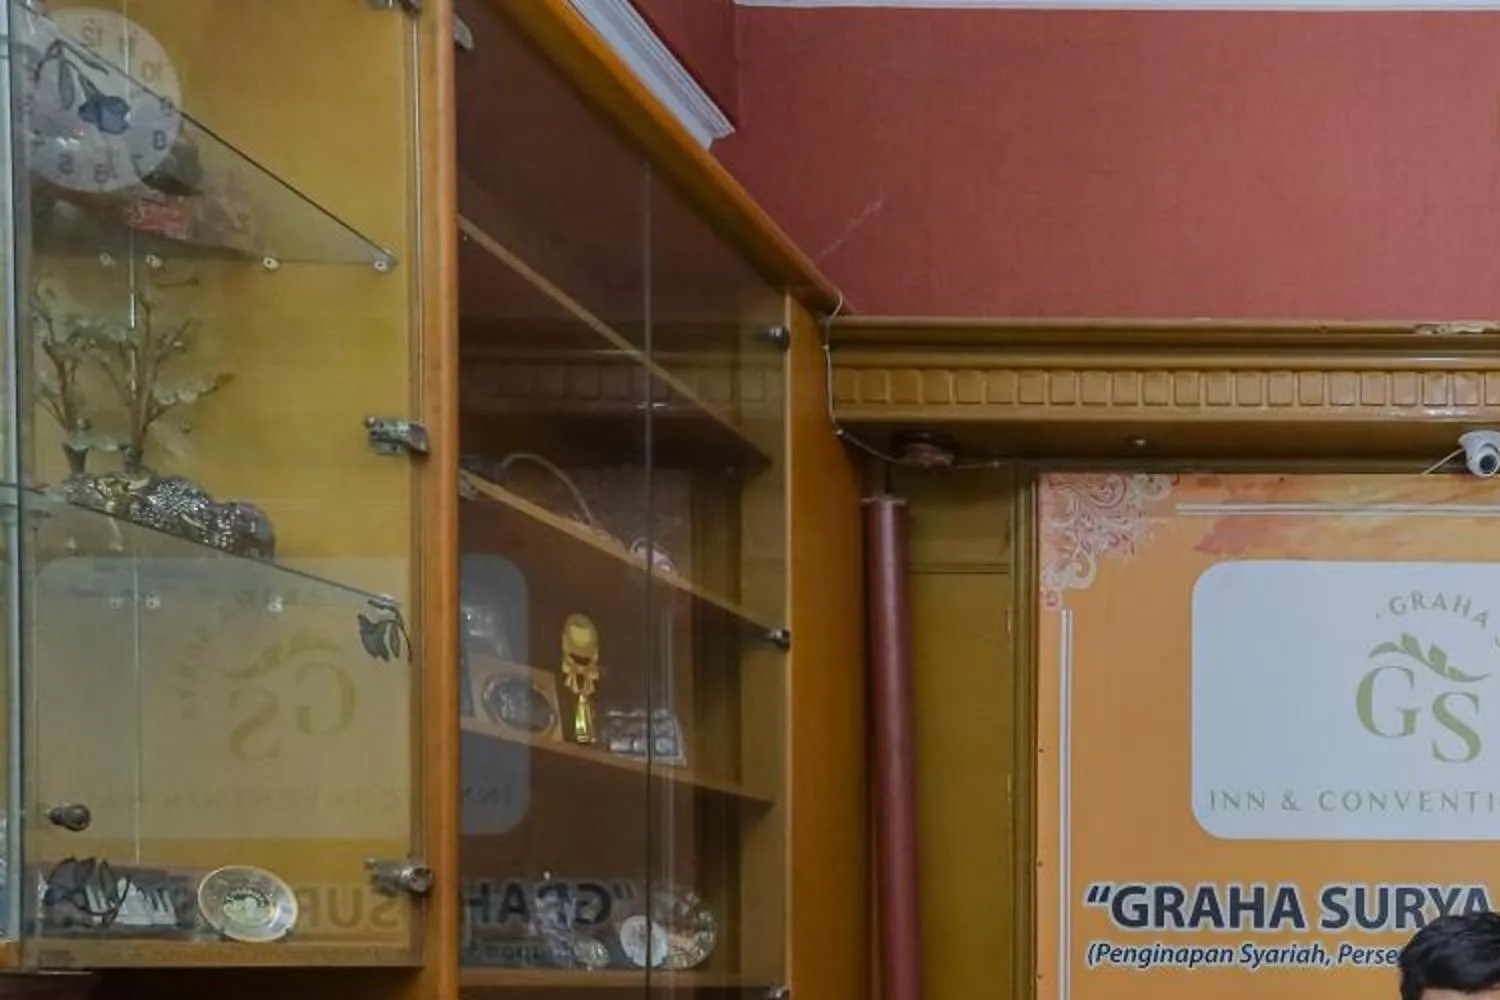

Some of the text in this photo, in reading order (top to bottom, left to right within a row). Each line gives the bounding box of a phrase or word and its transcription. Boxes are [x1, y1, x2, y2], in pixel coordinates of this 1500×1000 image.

[1389, 590, 1489, 629] GRAHA
[1355, 665, 1482, 763] GS
[1208, 789, 1266, 811] INN
[1280, 790, 1301, 812] &
[1087, 885, 1306, 930] “GRAHA
[1320, 885, 1491, 930] SURYA
[1087, 943, 1401, 969] (Penginapan Syariah, Perse
